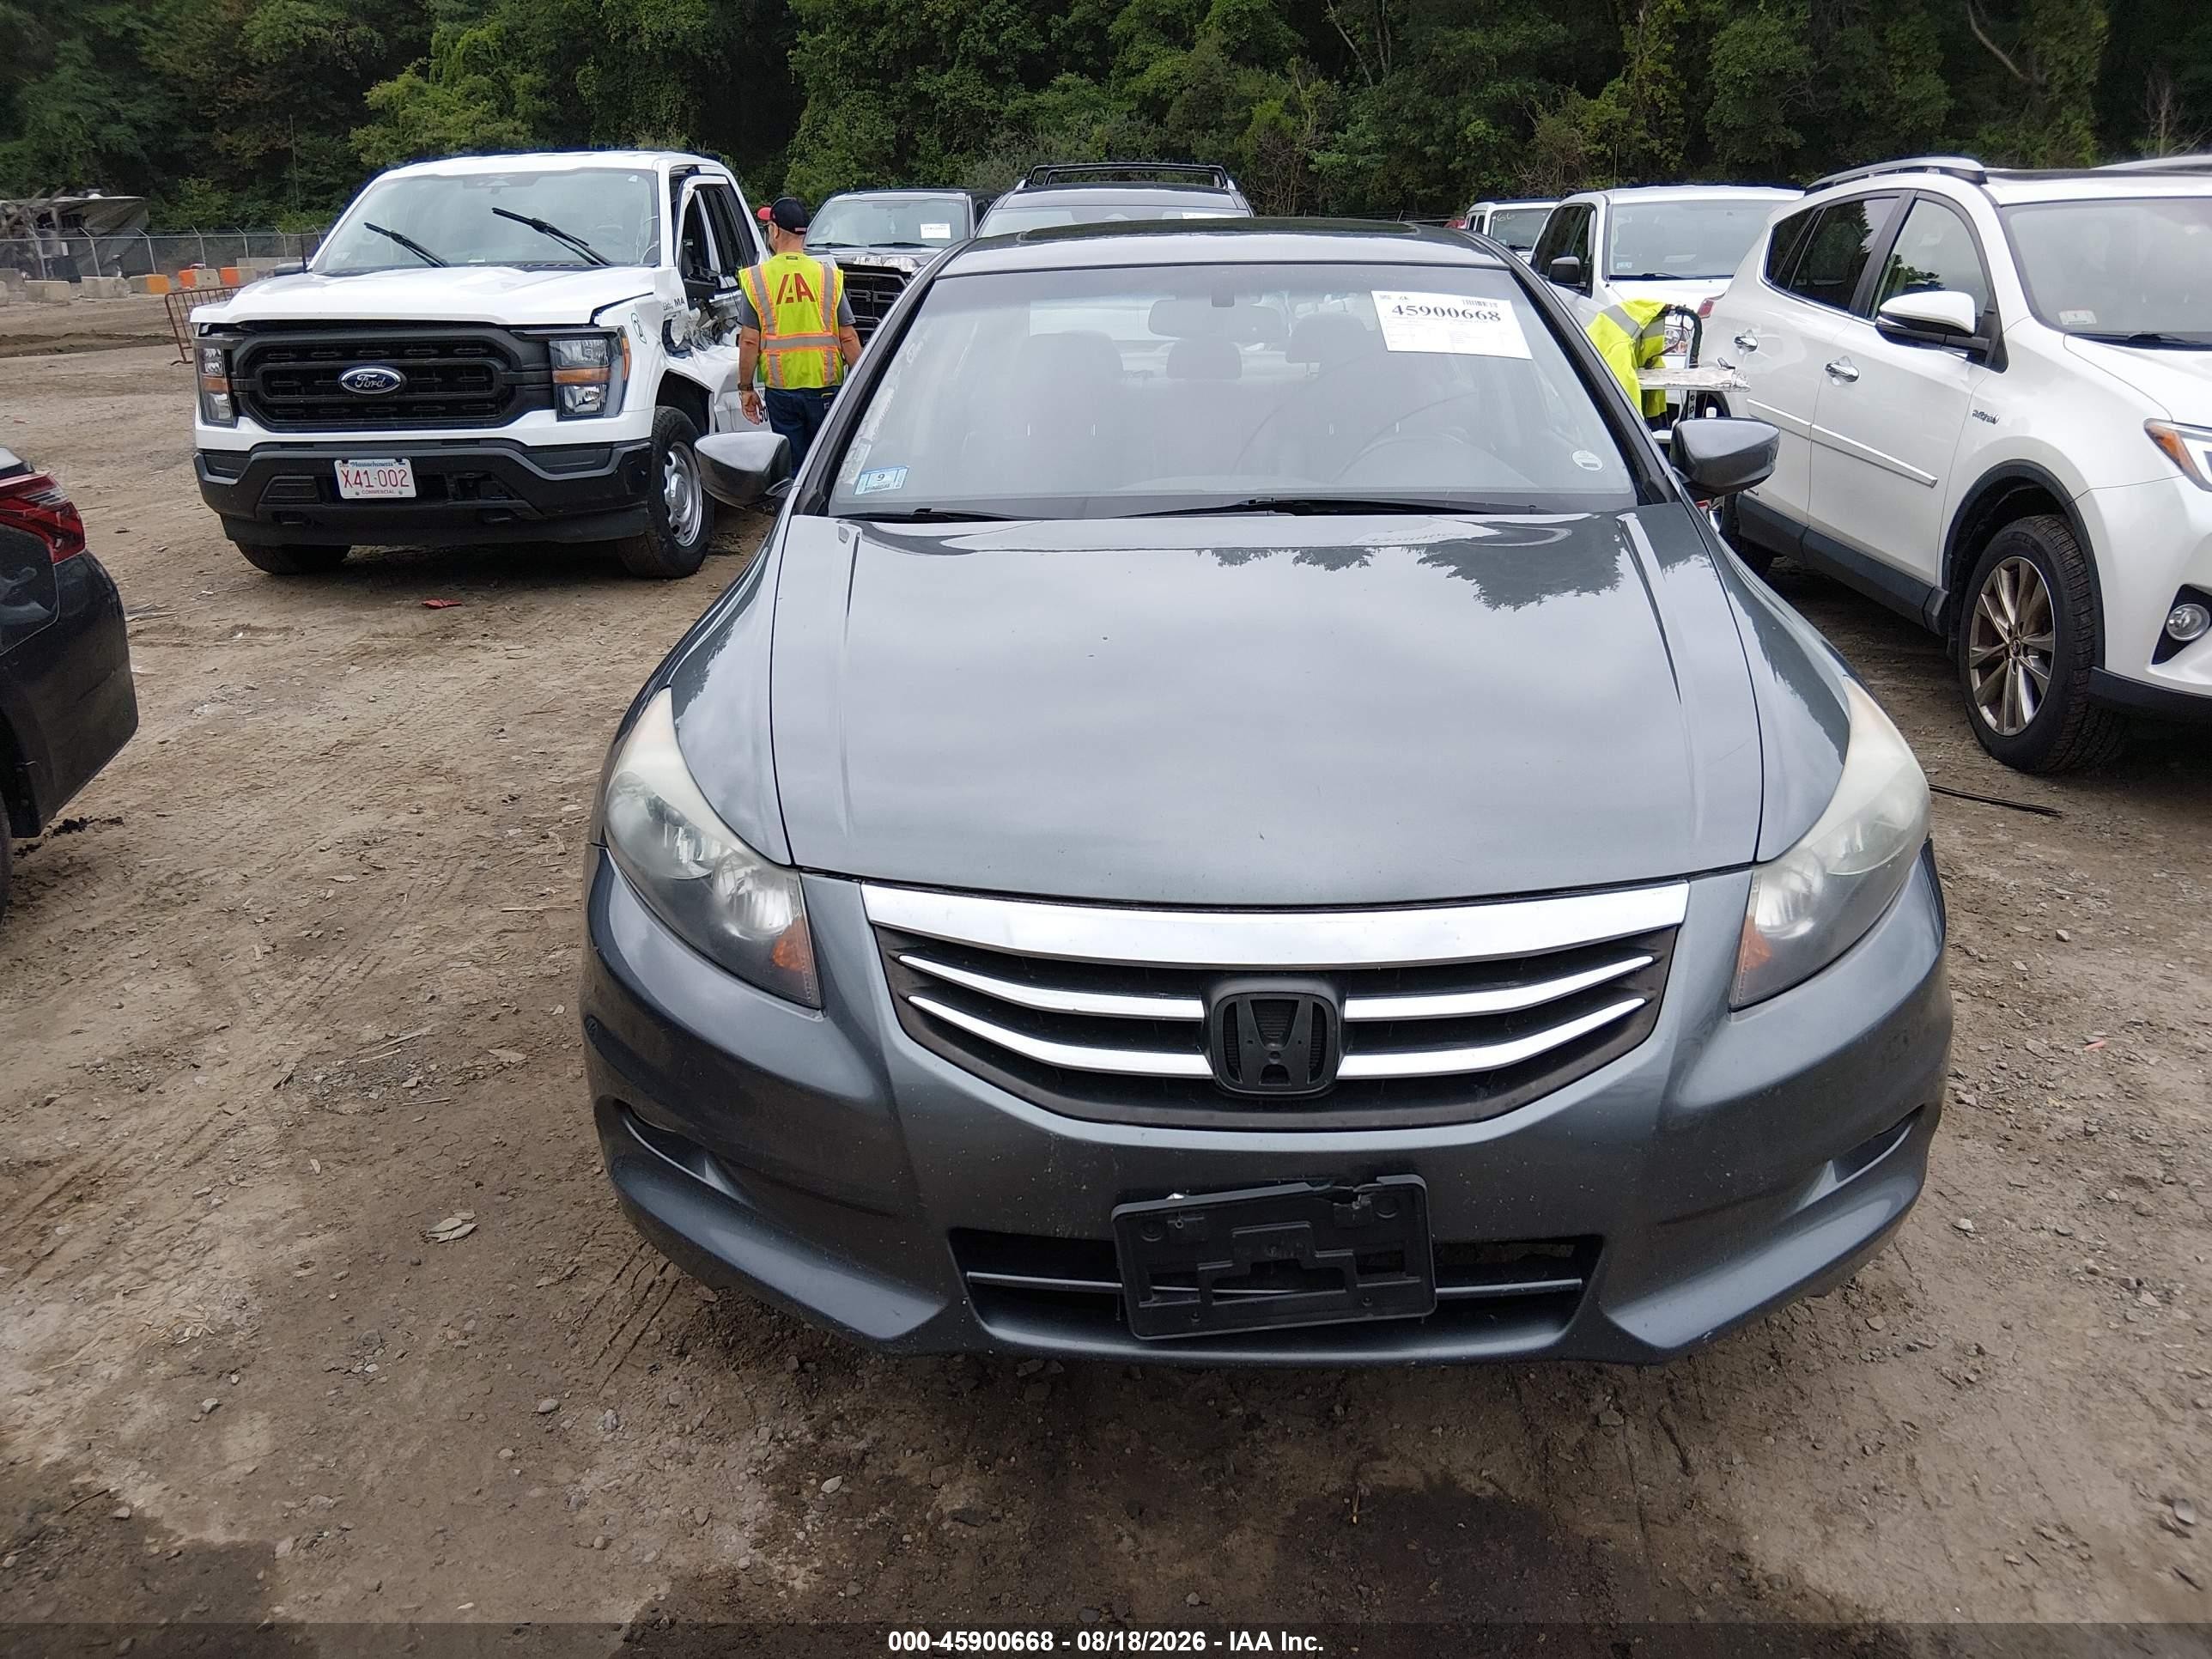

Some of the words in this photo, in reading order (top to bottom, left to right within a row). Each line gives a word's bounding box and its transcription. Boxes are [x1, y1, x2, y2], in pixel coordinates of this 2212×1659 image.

[1391, 304, 1502, 322] 45900668
[355, 374, 386, 388] Ford
[877, 473, 885, 482] 9
